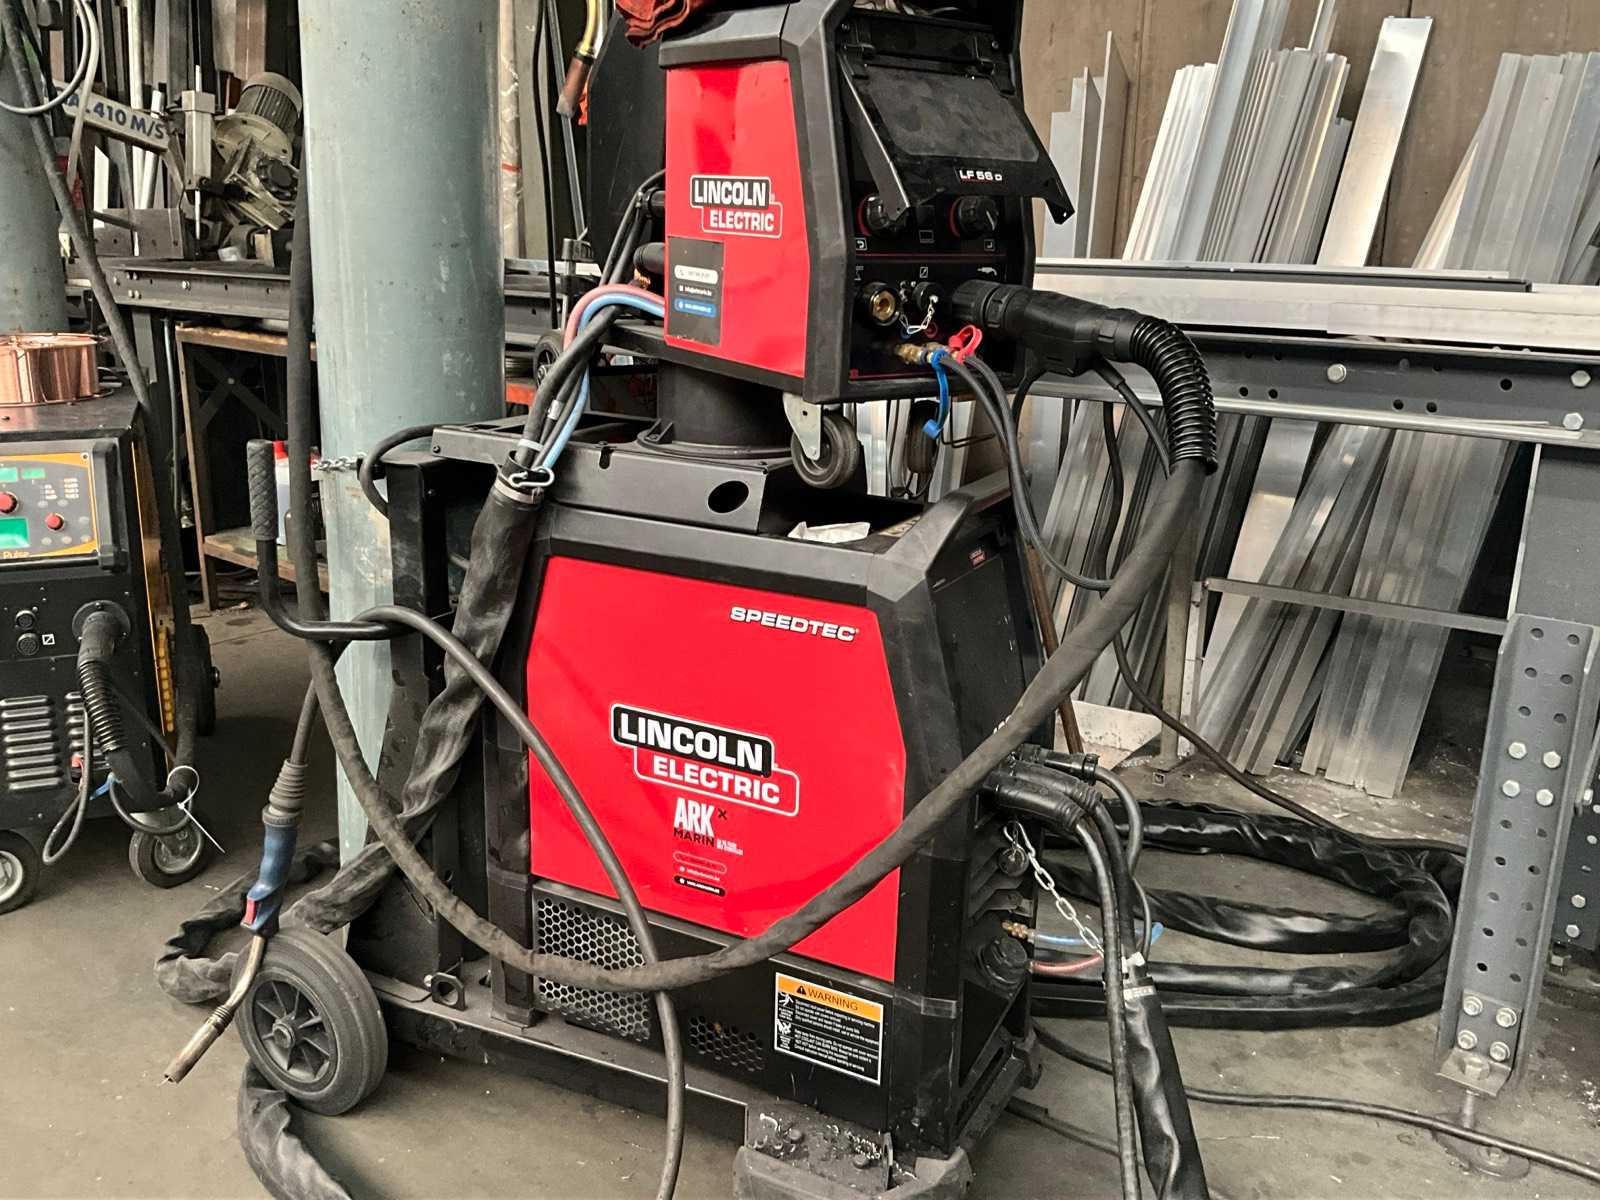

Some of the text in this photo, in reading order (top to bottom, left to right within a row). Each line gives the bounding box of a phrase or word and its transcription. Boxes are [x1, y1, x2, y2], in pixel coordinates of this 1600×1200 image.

[94, 101, 164, 139] 410 M/S
[959, 170, 974, 179] LF
[694, 180, 766, 206] LINCOLN
[709, 210, 774, 231] ELECTRIC
[730, 606, 855, 641] SPEEDTEC
[620, 713, 763, 772] LINCOLN
[653, 755, 780, 805] ELECTRIC
[673, 797, 715, 838] ARK
[673, 828, 715, 848] MARIN
[808, 988, 859, 1012] WARNING
